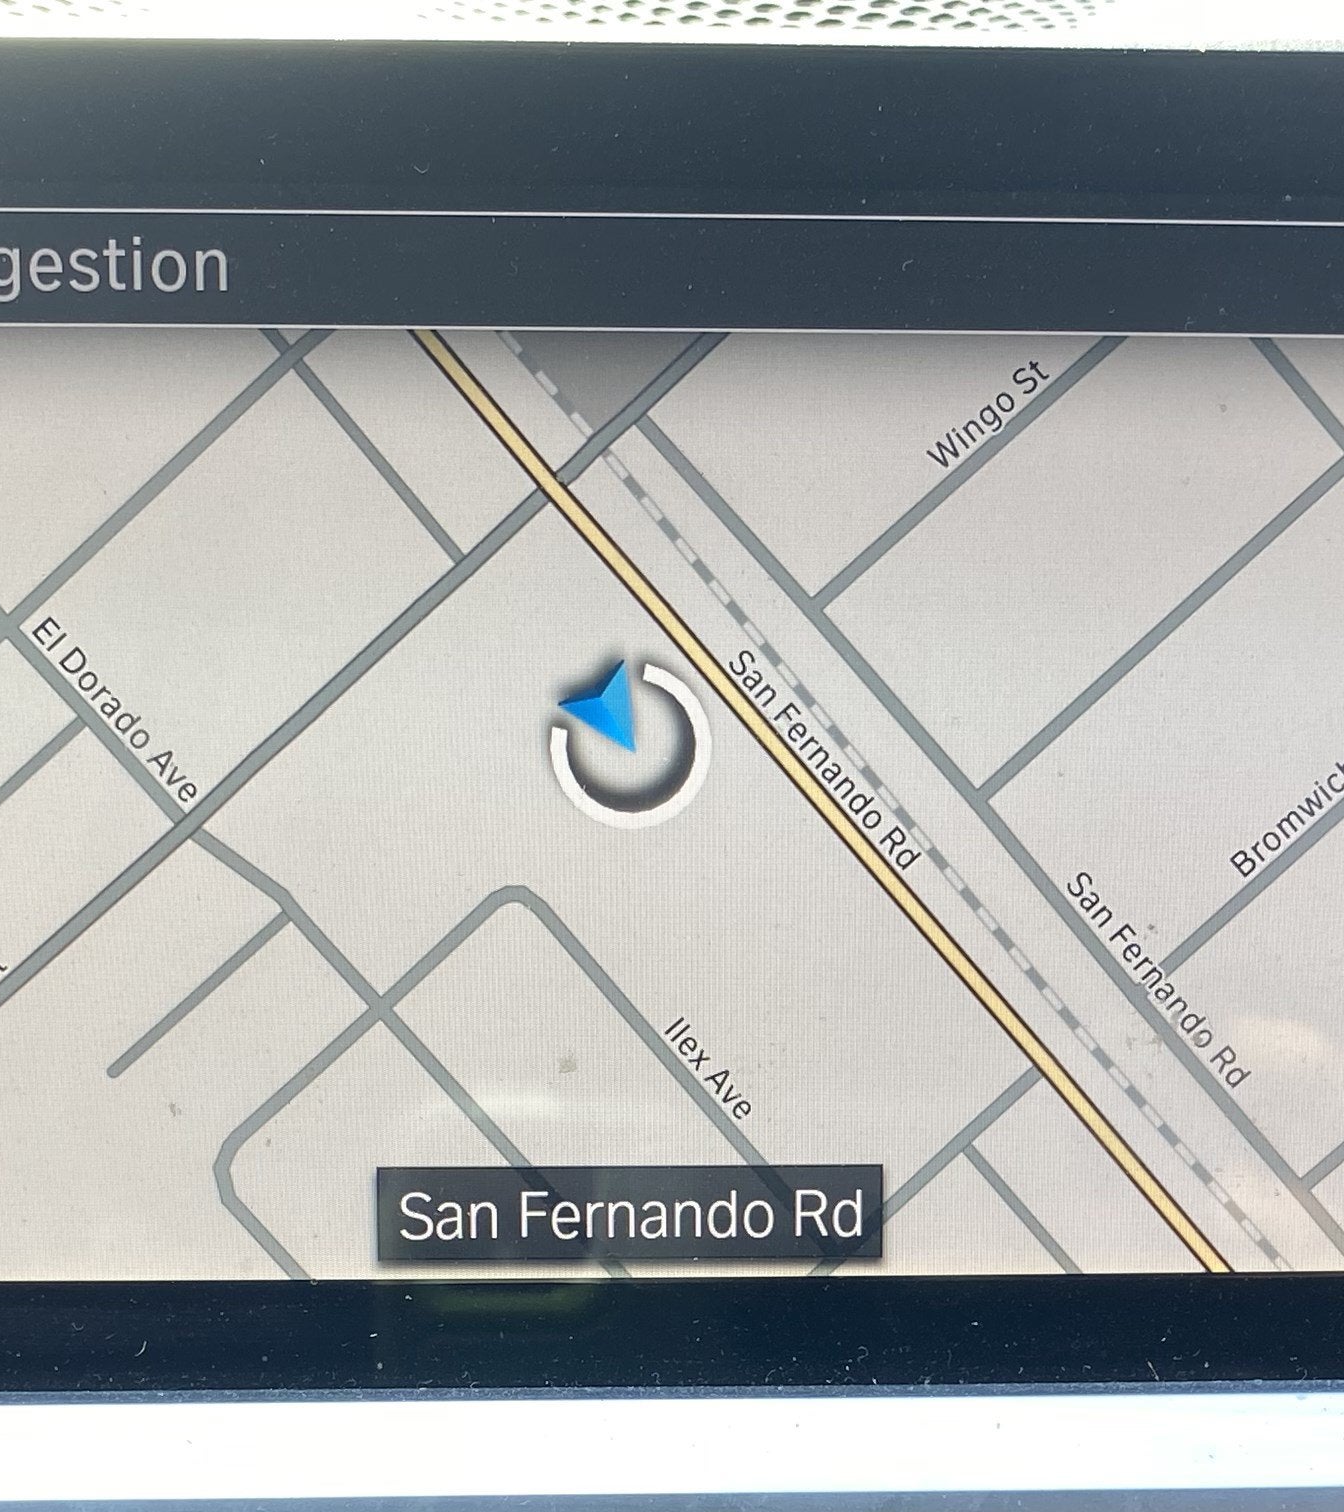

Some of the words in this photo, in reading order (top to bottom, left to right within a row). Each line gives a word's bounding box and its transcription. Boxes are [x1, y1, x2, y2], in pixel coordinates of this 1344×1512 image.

[926, 391, 1015, 468] Wingo
[1012, 360, 1050, 394] St
[31, 616, 67, 652] El
[58, 646, 150, 750] Dorado
[146, 750, 197, 803] Ave
[728, 650, 777, 707] San
[773, 702, 882, 830] Fernando
[879, 826, 922, 870] Rd
[1067, 872, 1113, 928] San
[1109, 923, 1213, 1048] Fernando
[1209, 1045, 1252, 1088] Rd
[664, 1016, 710, 1071] Ilex
[704, 1069, 751, 1120] Ave
[398, 1191, 500, 1241] San
[521, 1189, 774, 1240] Fernando
[795, 1188, 864, 1238] Rd
